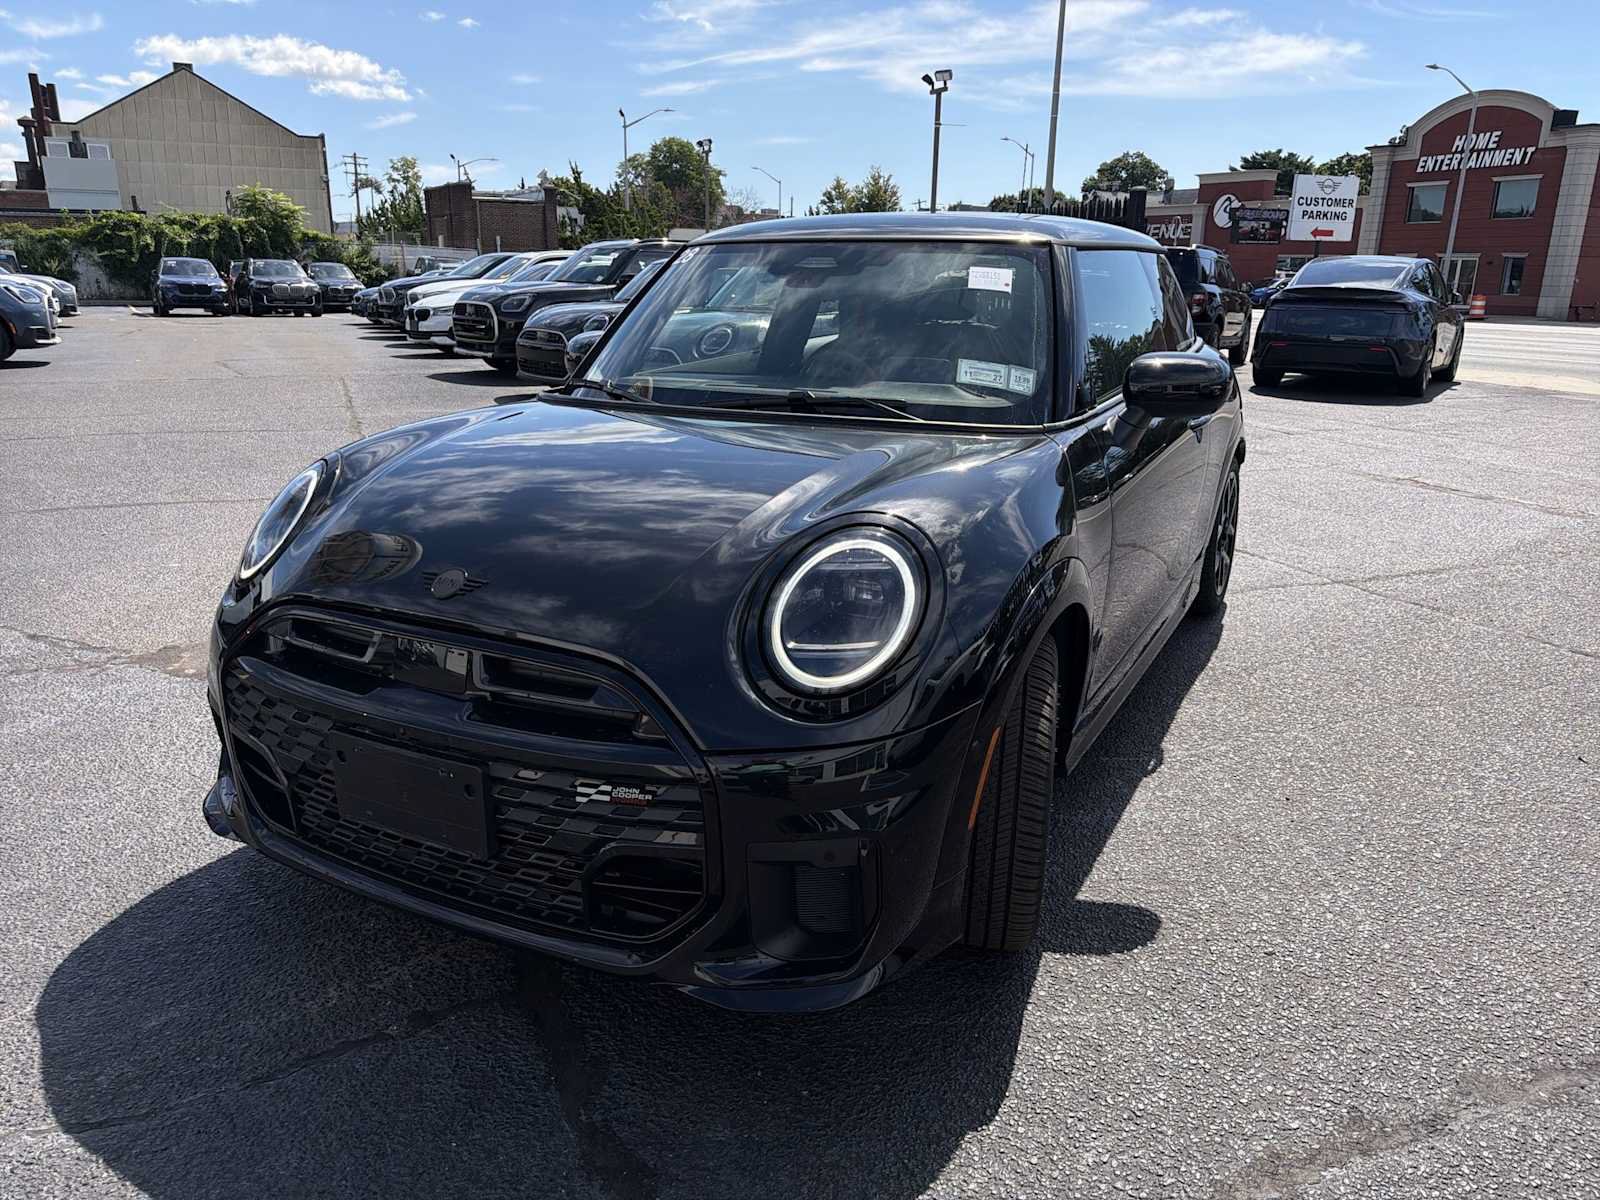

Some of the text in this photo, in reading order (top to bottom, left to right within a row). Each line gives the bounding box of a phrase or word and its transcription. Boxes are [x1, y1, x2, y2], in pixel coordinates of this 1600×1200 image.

[1452, 131, 1502, 152] HOME
[1416, 146, 1536, 173] ENTERTAINMENT
[1297, 196, 1354, 208] CUSTOMER
[1302, 209, 1348, 221] PARKING
[611, 792, 652, 800] COOPER
[612, 786, 640, 794] JOHN
